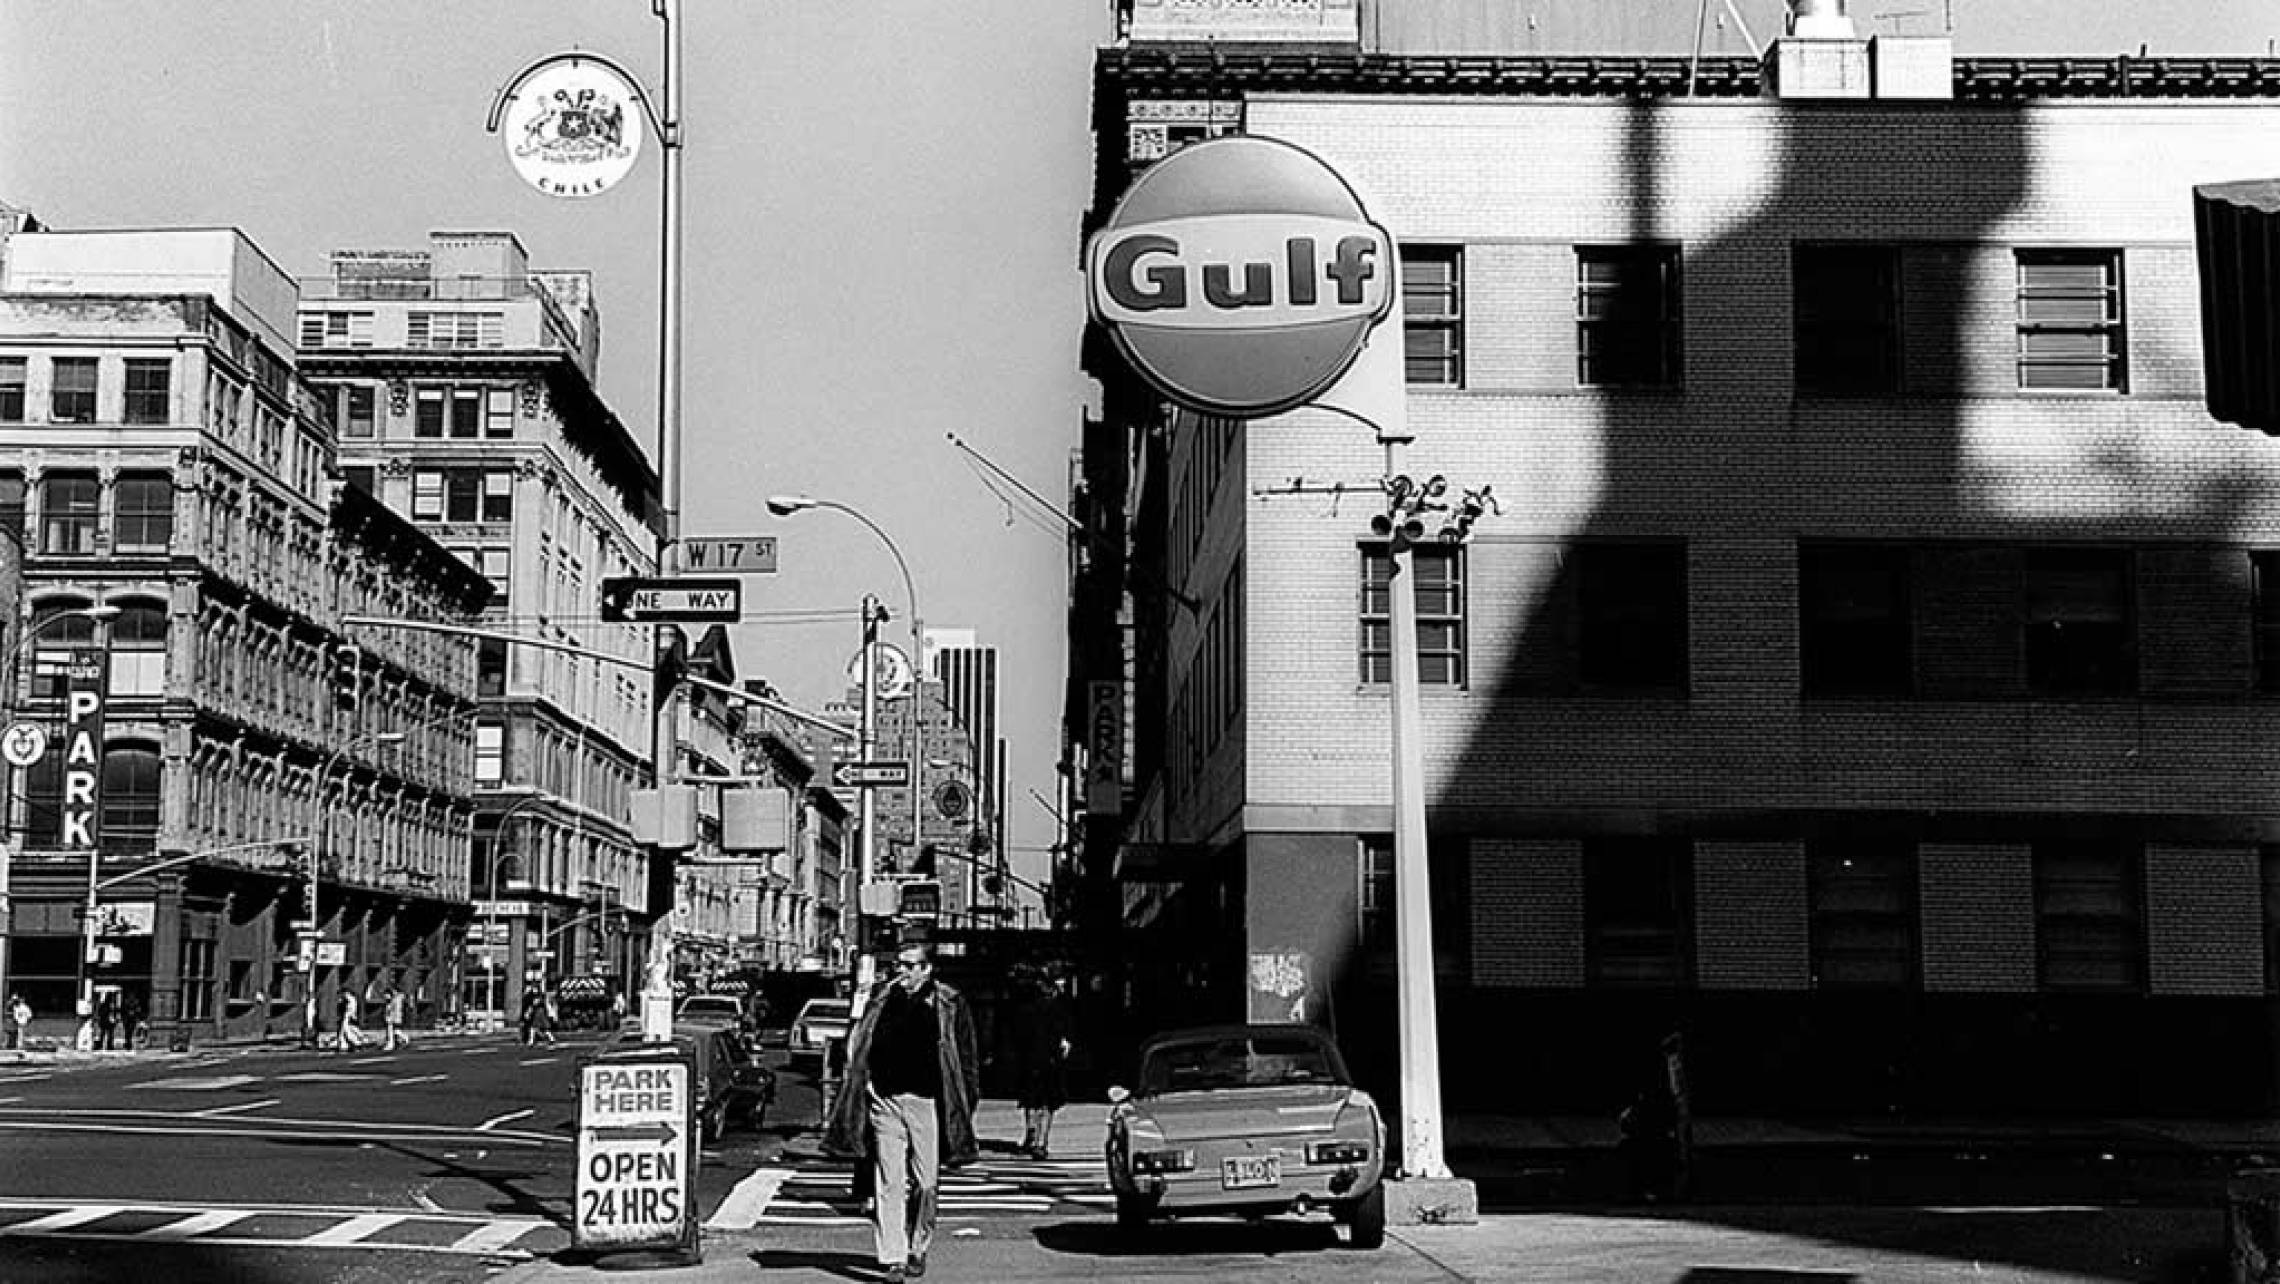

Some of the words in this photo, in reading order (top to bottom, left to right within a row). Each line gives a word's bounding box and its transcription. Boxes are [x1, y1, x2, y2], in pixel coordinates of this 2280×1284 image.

[538, 177, 603, 194] CHILE
[1104, 234, 1376, 311] Gulf
[688, 543, 707, 567] W
[718, 543, 744, 567] 17
[755, 543, 772, 556] ST
[629, 592, 661, 609] NE
[688, 592, 729, 608] WAY
[64, 691, 99, 845] PARK
[595, 1069, 671, 1091] PARK
[595, 1092, 672, 1113] HERE
[590, 1152, 677, 1182] OPEN
[582, 1189, 616, 1226] 24
[622, 1187, 680, 1225] HRS
